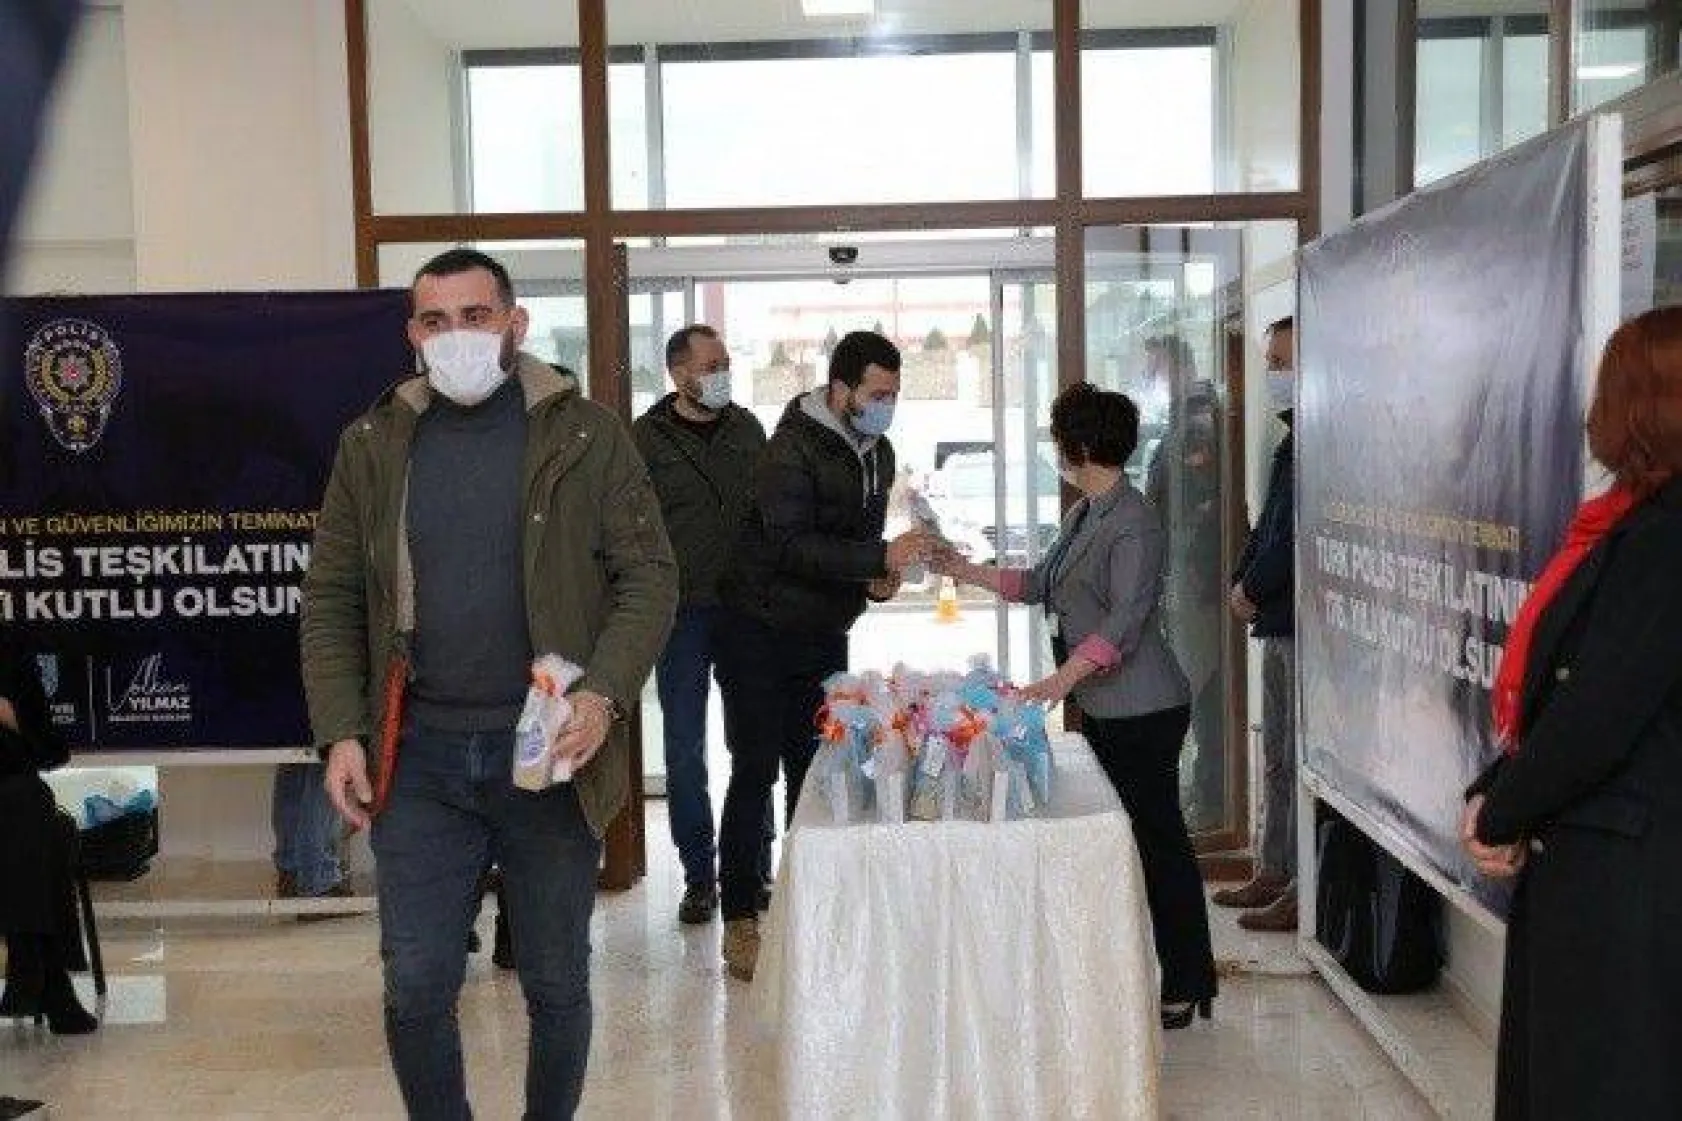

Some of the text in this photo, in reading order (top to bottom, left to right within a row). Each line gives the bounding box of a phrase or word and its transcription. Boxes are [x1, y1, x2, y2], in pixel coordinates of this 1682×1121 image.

[12, 517, 41, 534] VE
[26, 588, 162, 619] KUTLU
[129, 697, 191, 710] YILMAZ
